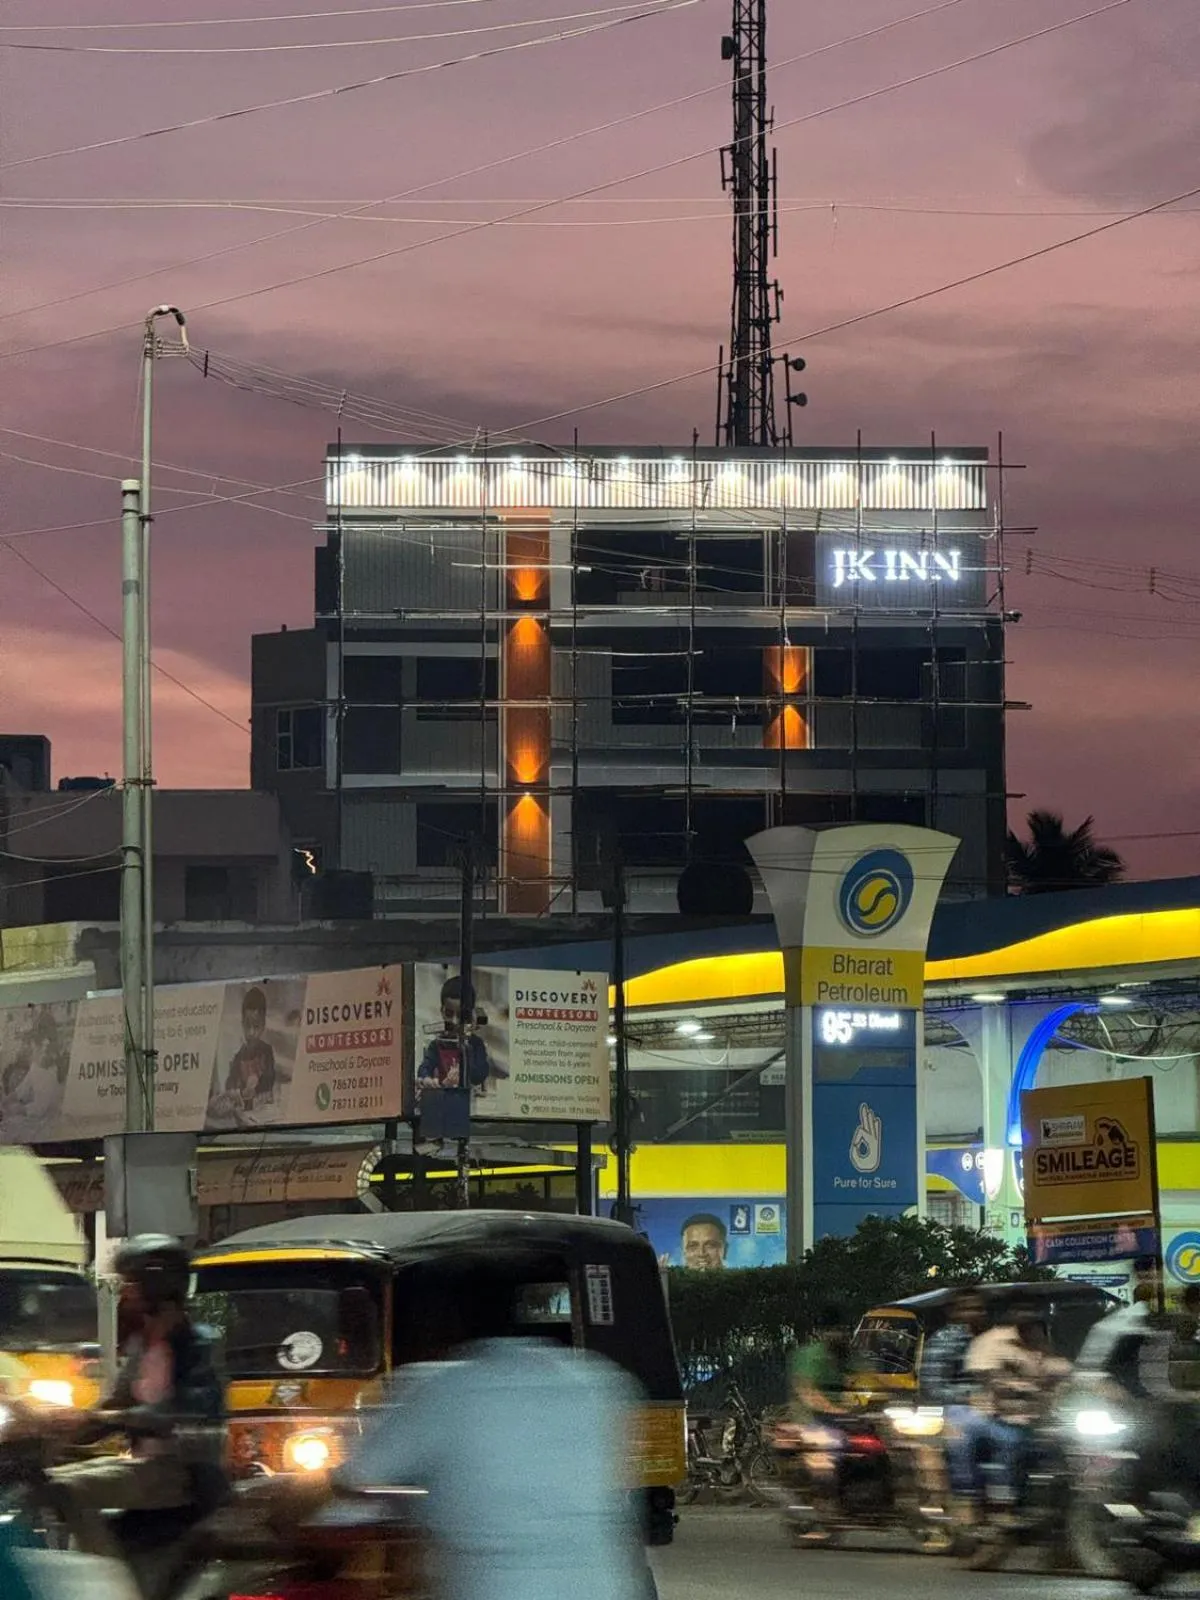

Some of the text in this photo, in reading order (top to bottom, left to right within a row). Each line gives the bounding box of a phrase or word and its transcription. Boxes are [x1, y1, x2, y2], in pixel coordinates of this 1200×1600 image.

[833, 549, 962, 588] JK INN
[833, 954, 894, 976] Bharat
[515, 989, 598, 1005] DISCOVERY
[817, 981, 909, 1004] Petroleum
[306, 1000, 393, 1025] DISCOVERY
[516, 1008, 598, 1019] MONTESSORI
[516, 1021, 556, 1032] Preschool
[564, 1022, 597, 1033] Daycare
[307, 1029, 393, 1050] MONTESSORI
[163, 1052, 200, 1073] OPEN
[309, 1057, 347, 1073] Preschool
[356, 1055, 392, 1073] Daycare
[515, 1073, 600, 1086] ADMISSIONS OPEN
[1036, 1147, 1138, 1175] SMILEAGE
[833, 1176, 897, 1190] Pure for Sure
